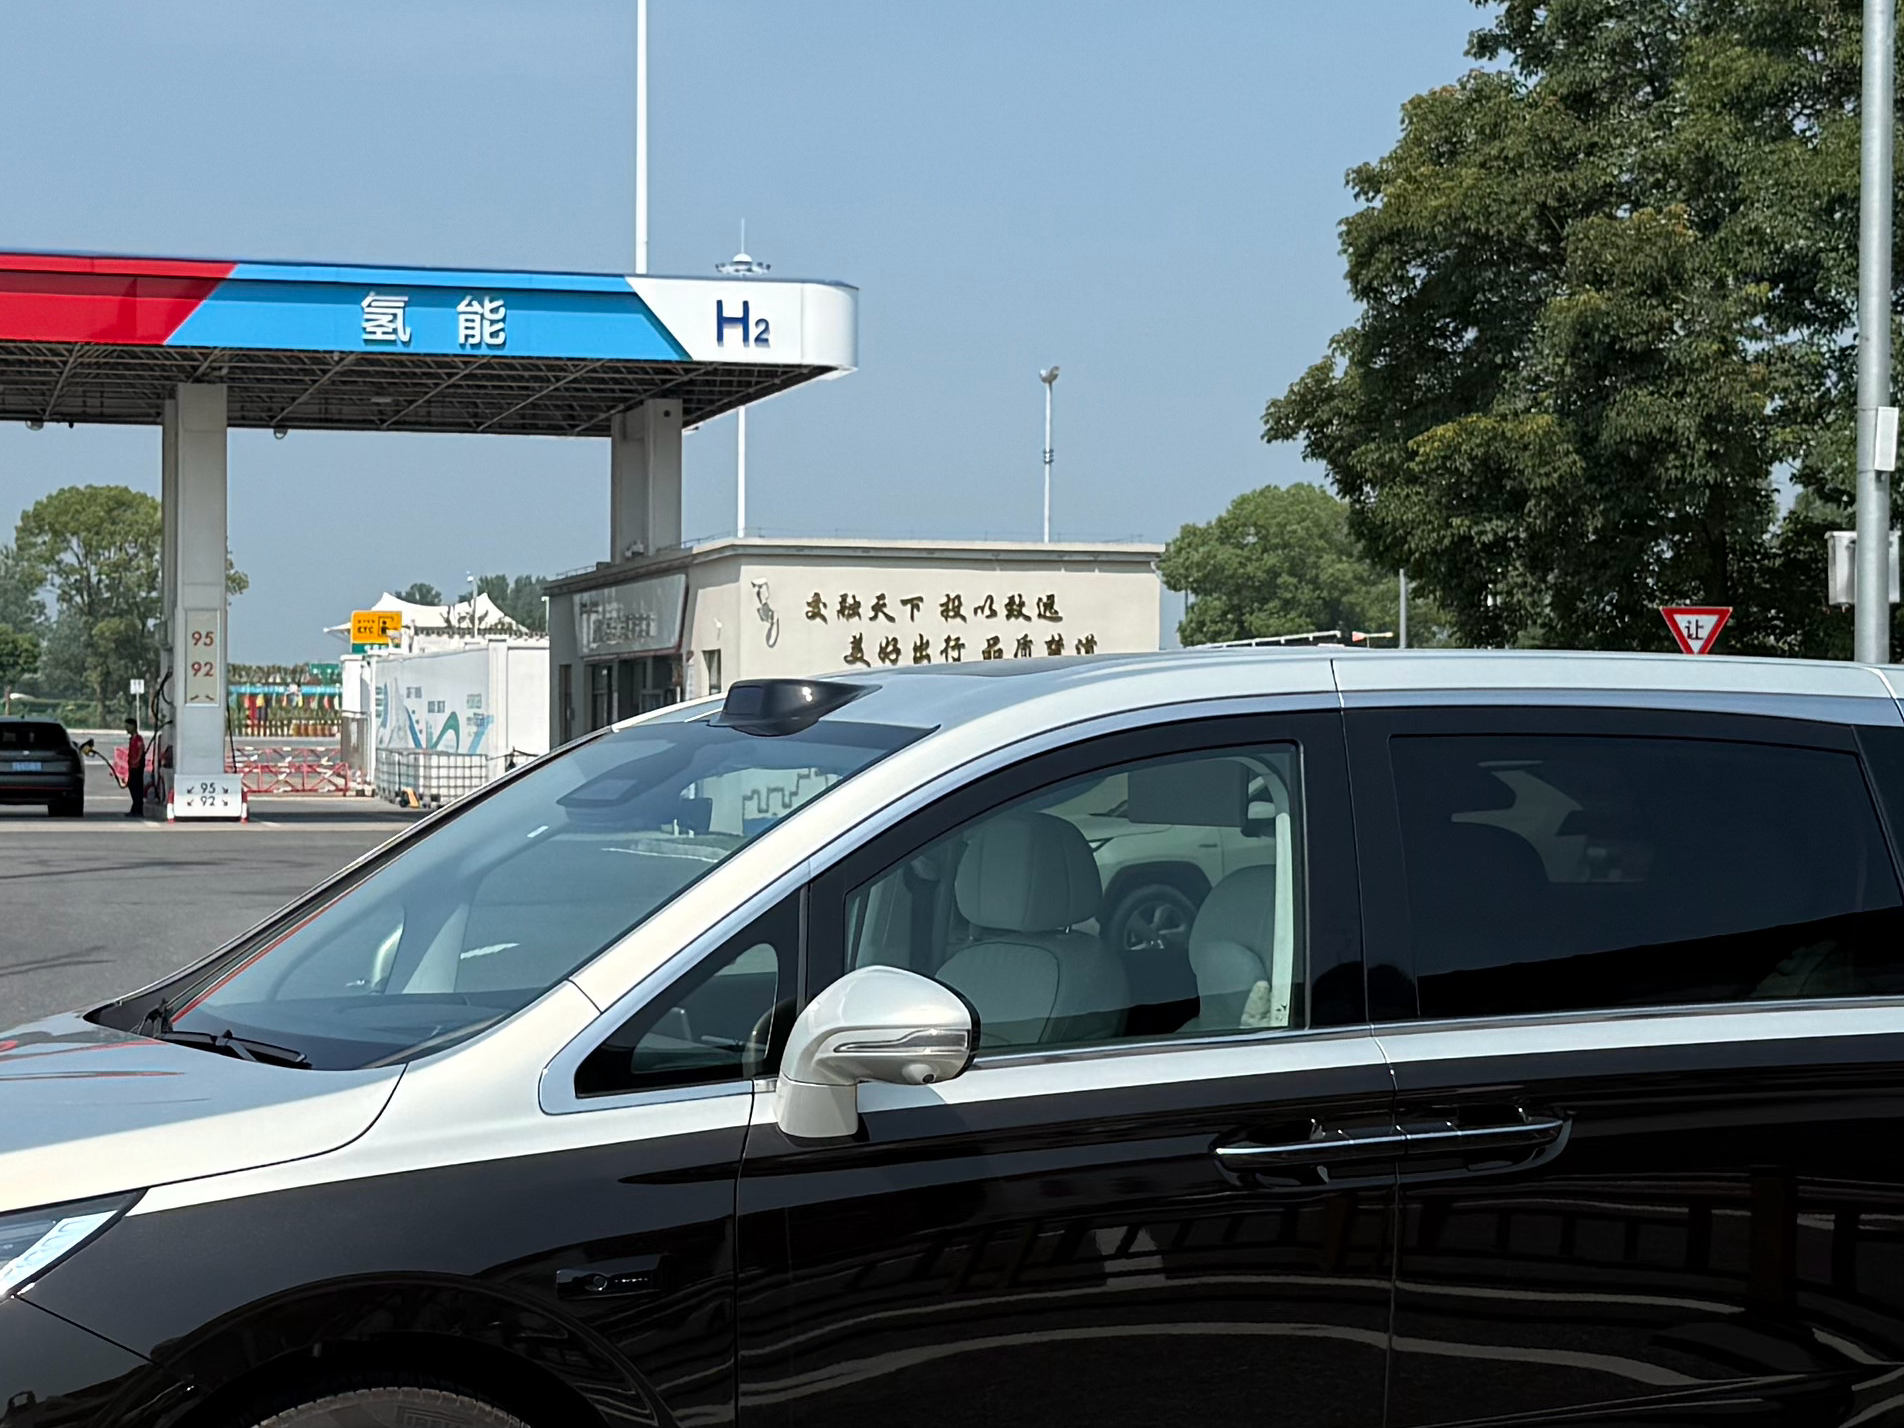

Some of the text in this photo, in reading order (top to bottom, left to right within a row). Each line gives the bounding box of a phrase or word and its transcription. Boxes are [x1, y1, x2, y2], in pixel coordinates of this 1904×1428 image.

[362, 291, 507, 346] 氢能
[715, 299, 771, 347] H2
[805, 592, 924, 624] 交融天下
[1684, 618, 1704, 640] 让
[191, 631, 215, 647] 95
[191, 661, 215, 677] 92
[200, 782, 216, 794] 95
[200, 795, 216, 807] 92
